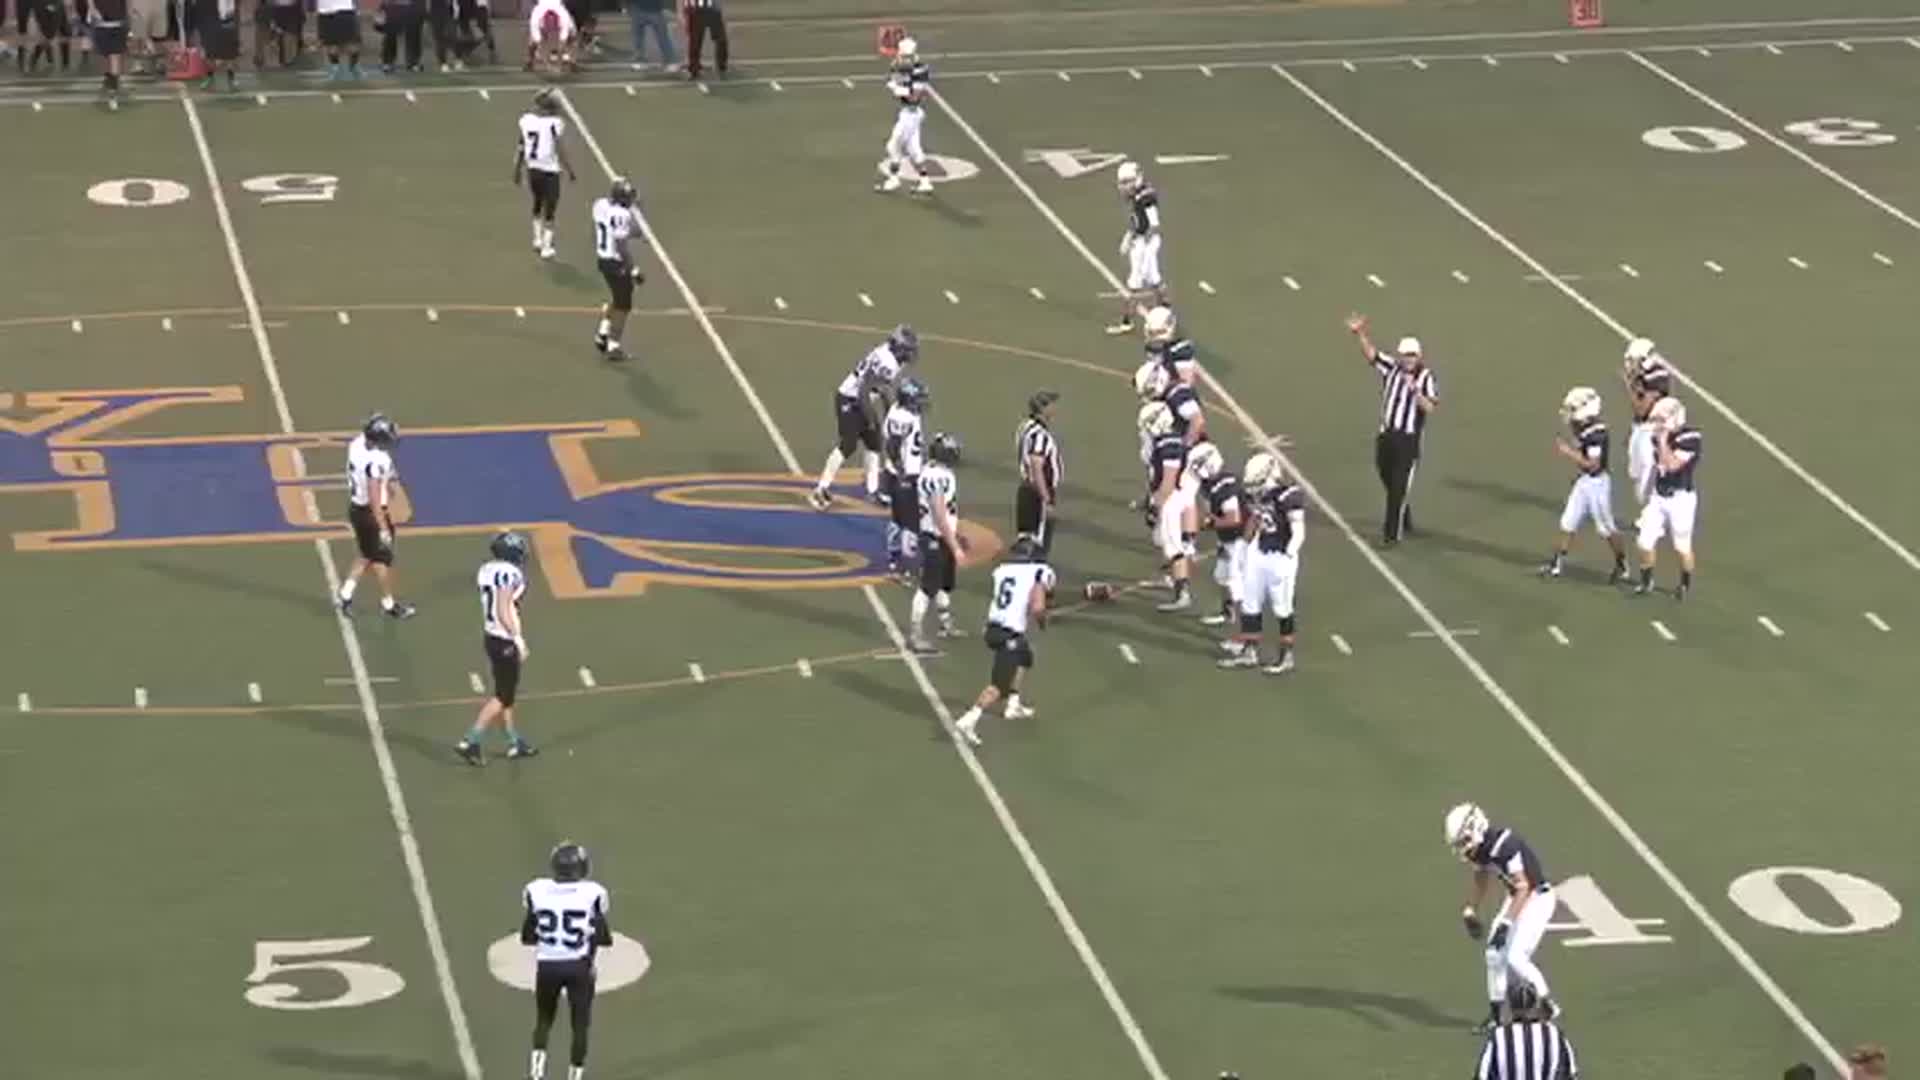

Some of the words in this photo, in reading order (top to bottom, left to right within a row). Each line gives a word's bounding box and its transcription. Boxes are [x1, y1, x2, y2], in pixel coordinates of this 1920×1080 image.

[528, 131, 539, 160] 7
[998, 576, 1016, 611] 6
[536, 908, 588, 951] 25
